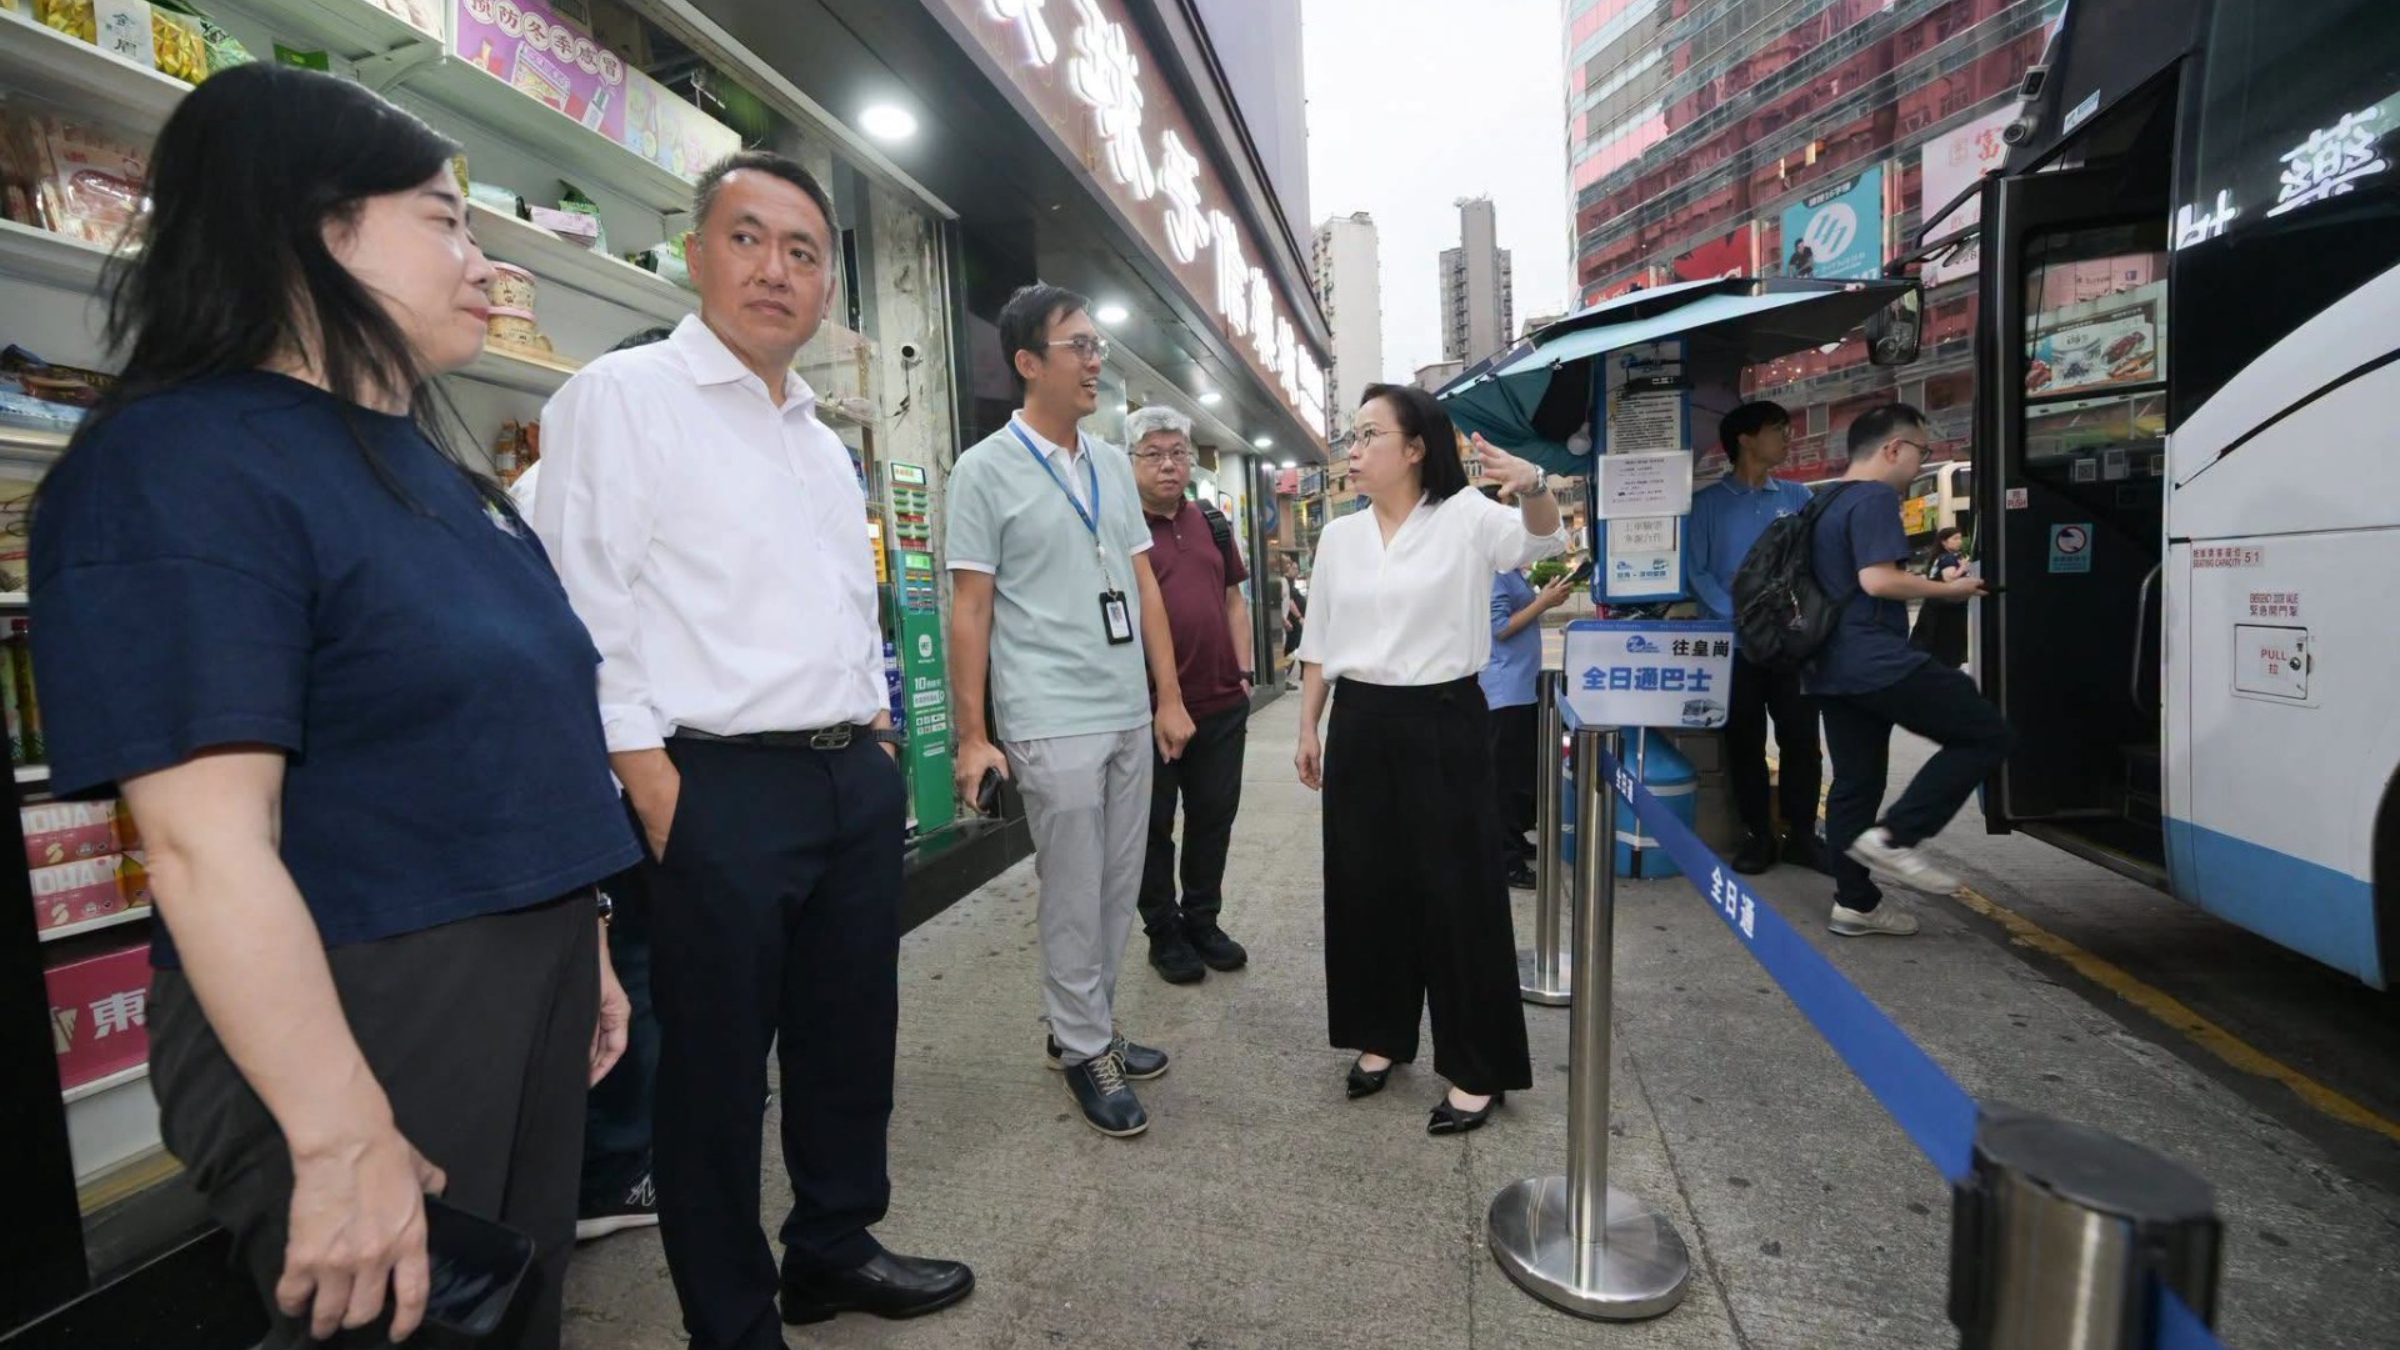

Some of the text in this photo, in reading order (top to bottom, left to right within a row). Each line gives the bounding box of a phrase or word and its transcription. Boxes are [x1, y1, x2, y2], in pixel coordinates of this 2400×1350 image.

[1672, 639, 1729, 658] 往皇崗
[2260, 648, 2287, 661] PULL
[1582, 666, 1713, 692] 全日通巴士
[2268, 663, 2279, 675] 拉
[1711, 865, 1755, 939] 全日通
[89, 988, 147, 1040] 東
